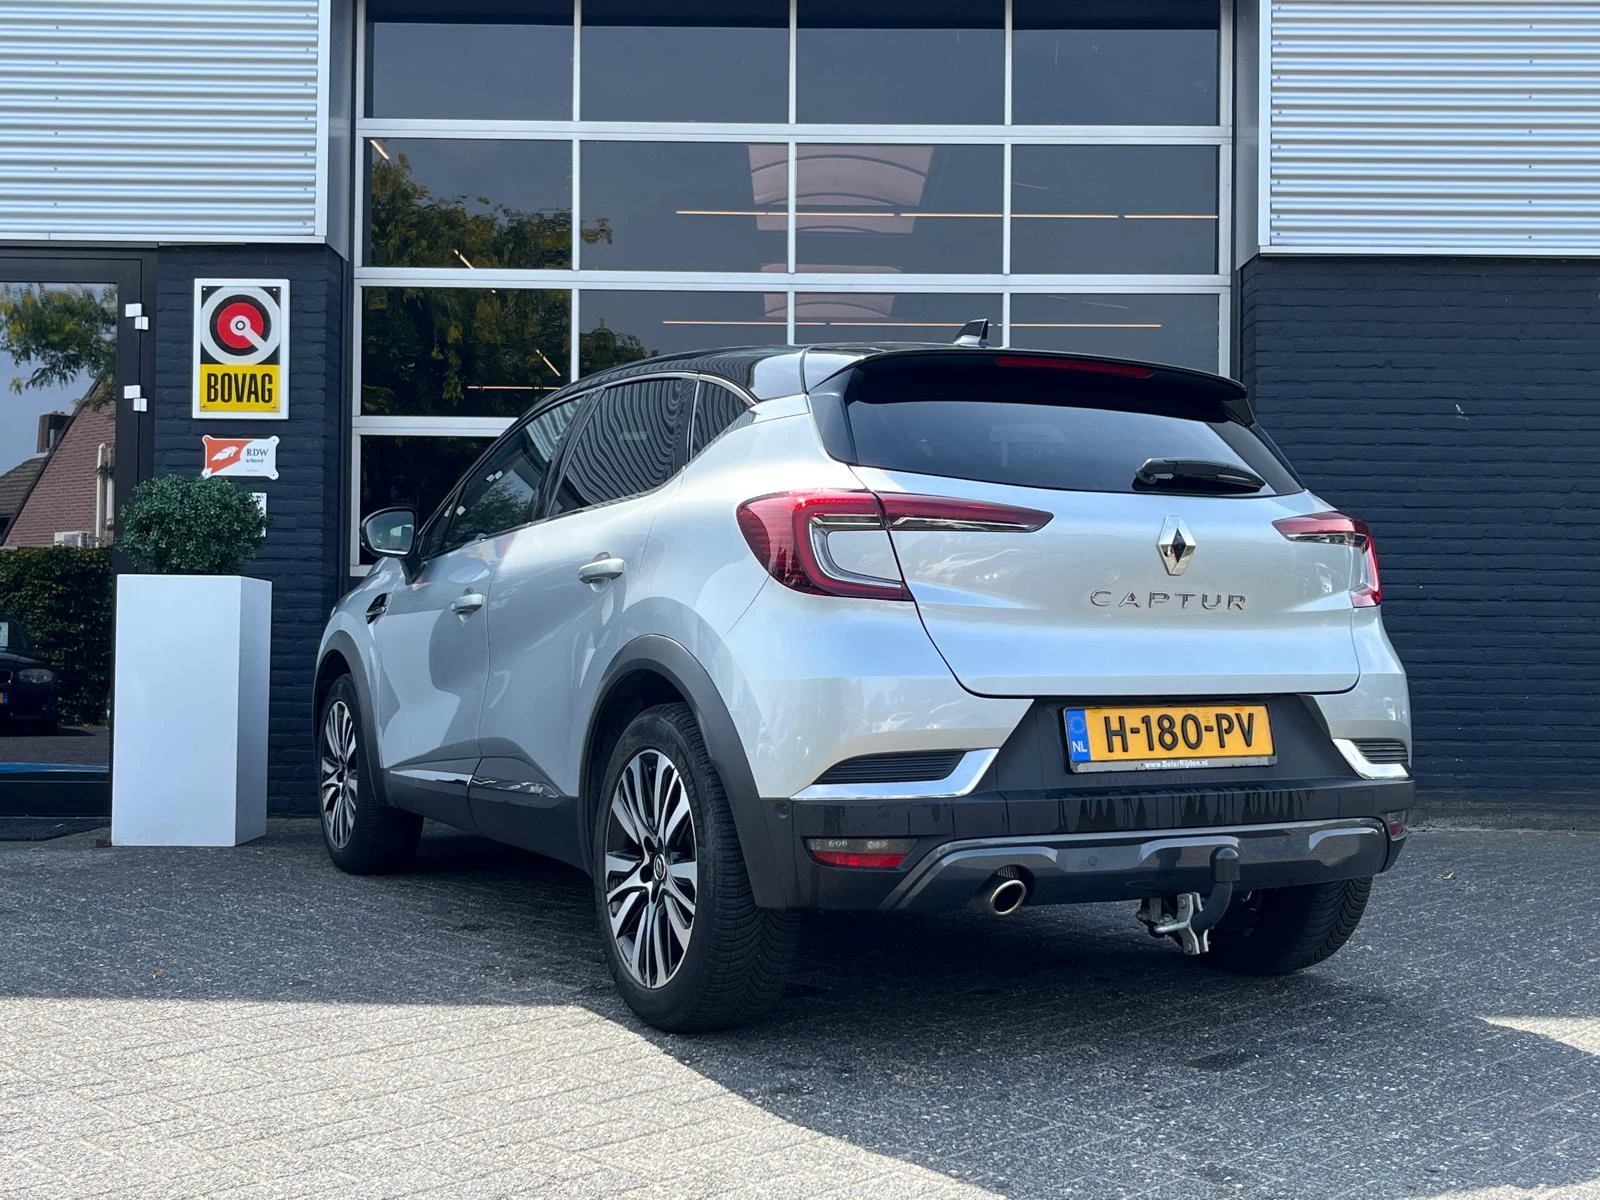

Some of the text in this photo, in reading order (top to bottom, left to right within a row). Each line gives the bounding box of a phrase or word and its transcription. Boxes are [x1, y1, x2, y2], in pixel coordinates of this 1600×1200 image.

[206, 372, 273, 404] BOVAG
[246, 448, 269, 457] RDW
[1089, 590, 1247, 611] CAPTUR
[1104, 712, 1255, 753] H-180-PV
[1072, 740, 1088, 754] NL
